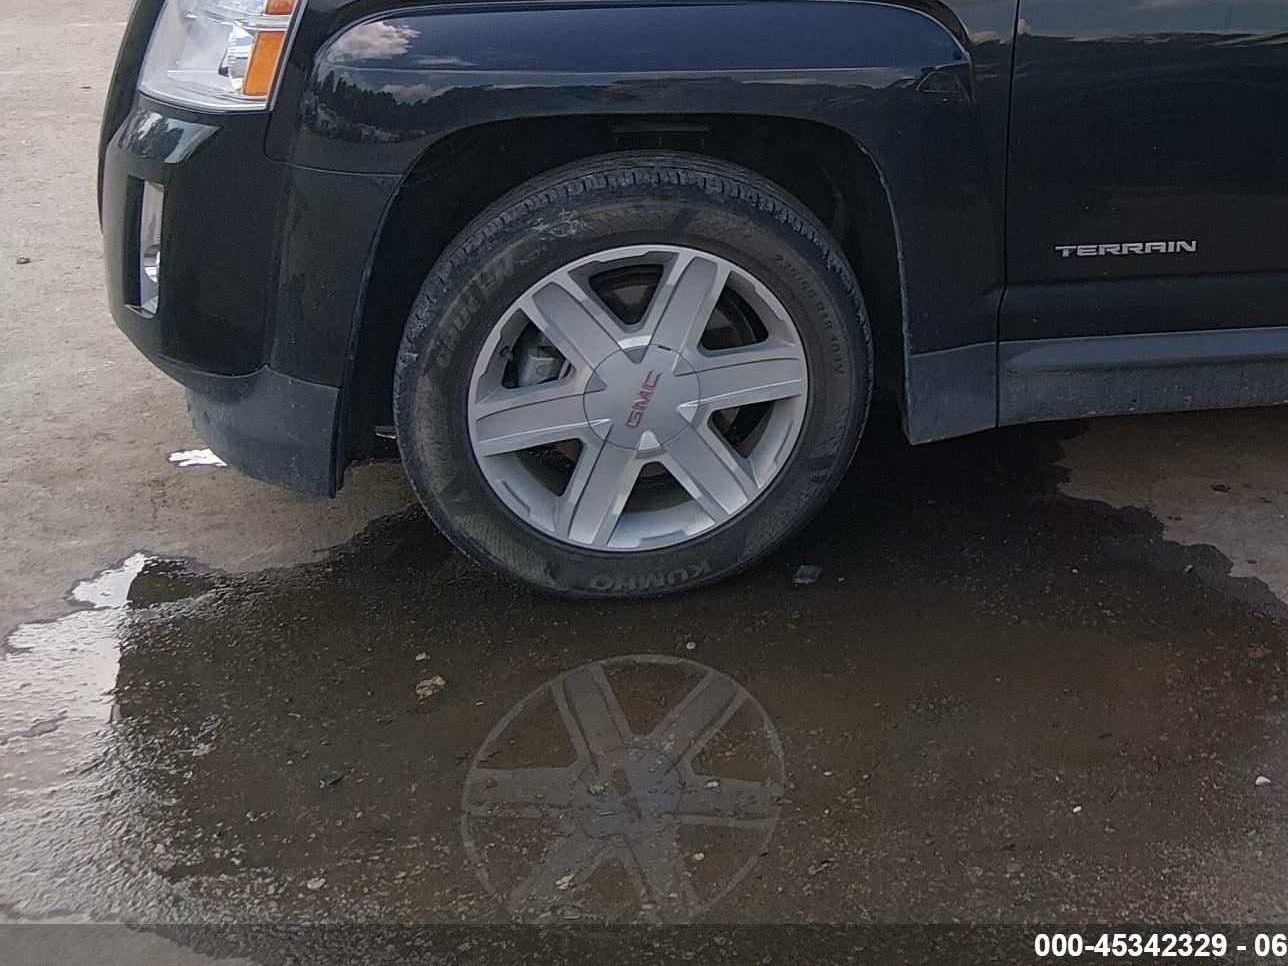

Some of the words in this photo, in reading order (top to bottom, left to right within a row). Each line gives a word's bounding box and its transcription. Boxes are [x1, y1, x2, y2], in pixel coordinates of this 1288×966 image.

[1054, 240, 1198, 258] TERRAIN
[624, 369, 663, 428] GMC
[588, 560, 710, 591] KUMHO
